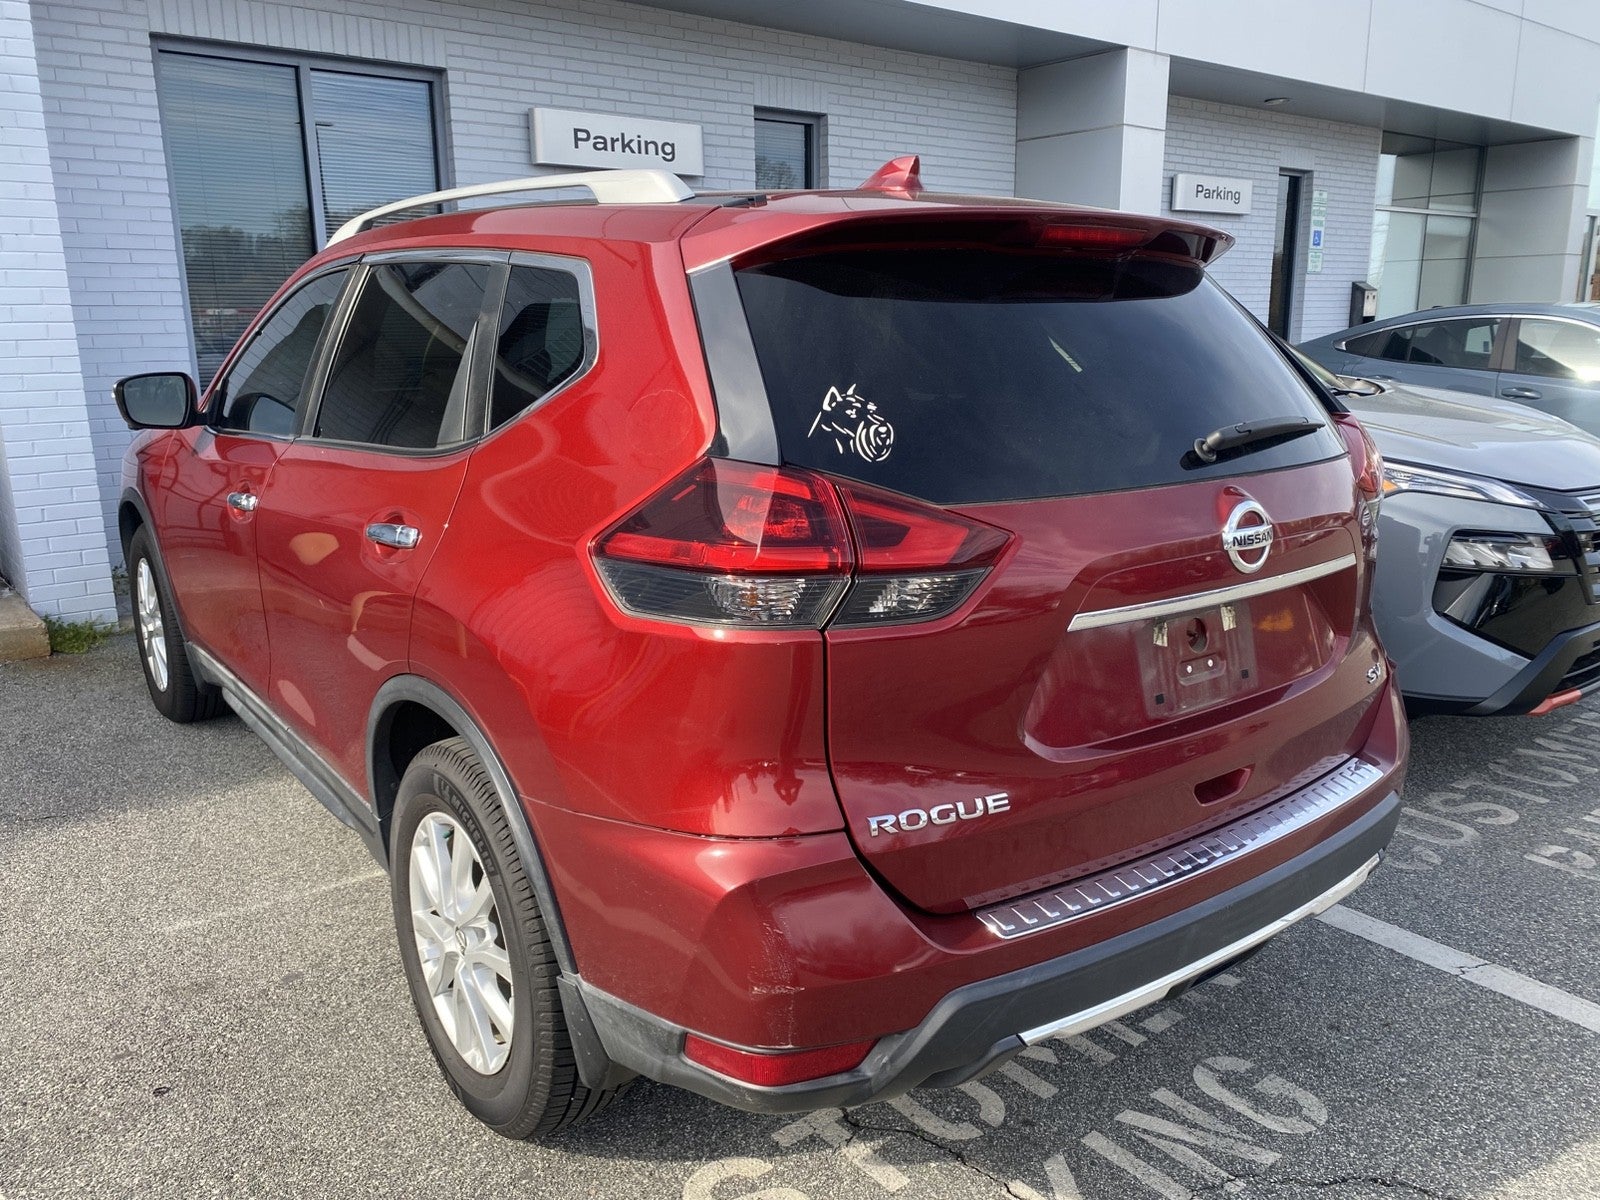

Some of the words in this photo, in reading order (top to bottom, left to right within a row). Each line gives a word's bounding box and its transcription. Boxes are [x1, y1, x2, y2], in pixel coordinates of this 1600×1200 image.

[573, 127, 676, 162] Parking
[1195, 183, 1241, 205] Parking
[1232, 530, 1273, 547] NISSAN
[1366, 662, 1381, 684] SV
[867, 792, 1011, 837] ROGUE
